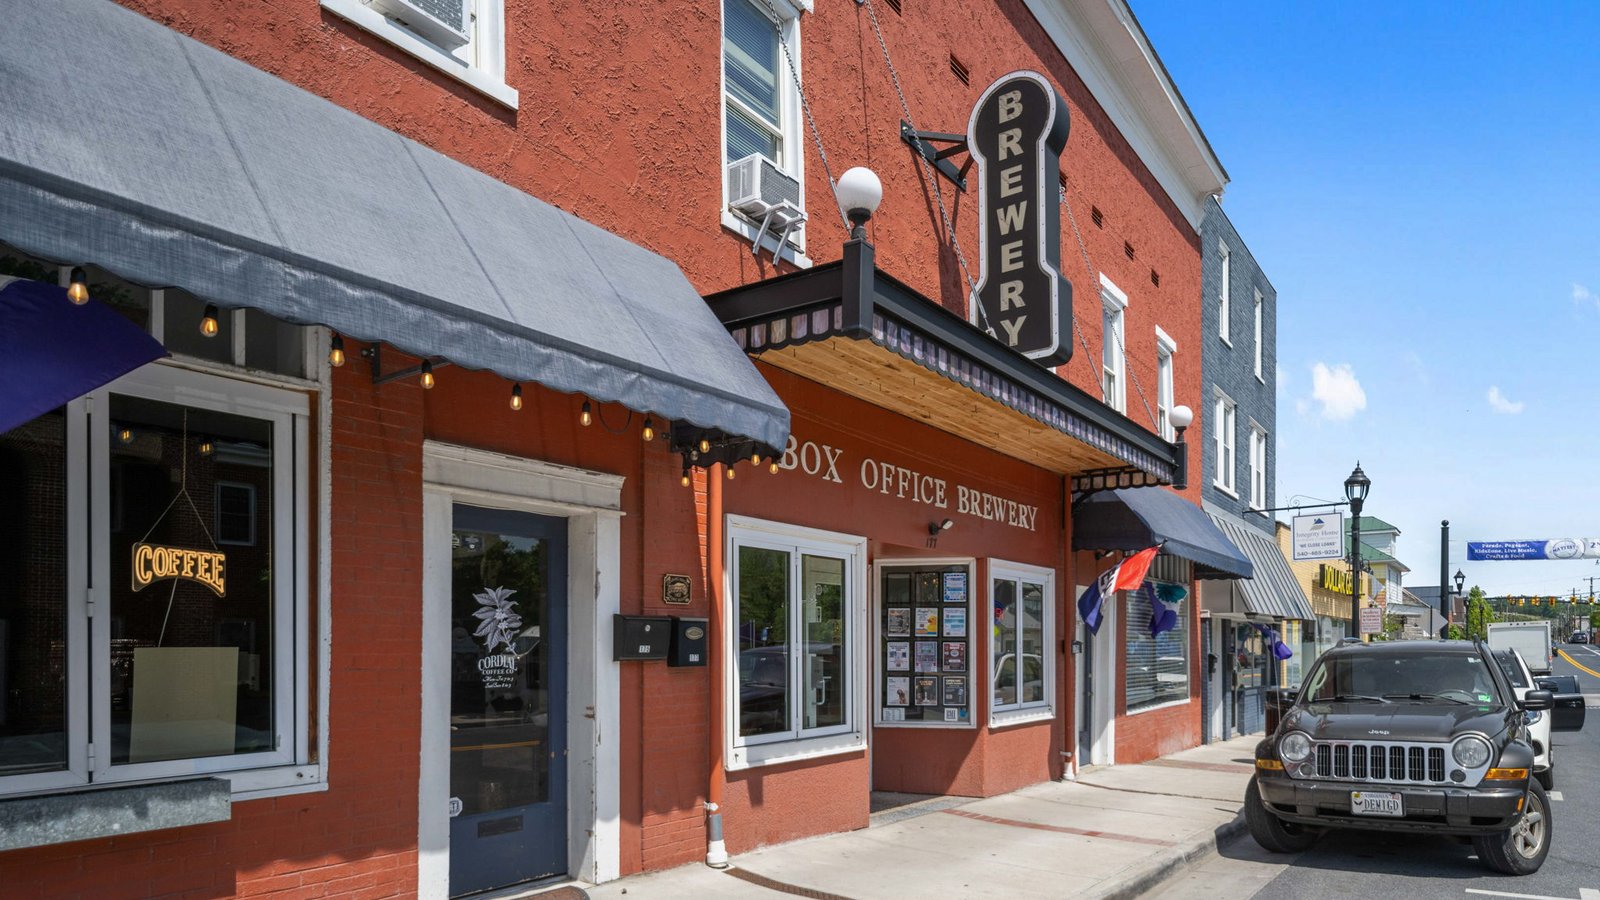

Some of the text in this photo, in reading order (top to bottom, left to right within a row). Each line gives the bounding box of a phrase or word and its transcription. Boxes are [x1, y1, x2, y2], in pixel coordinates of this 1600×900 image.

[997, 89, 1027, 347] BREWERY
[778, 434, 1038, 532] BOX OFFICE BREWERY
[135, 544, 225, 594] COFFEE
[478, 655, 517, 671] CORDIAL
